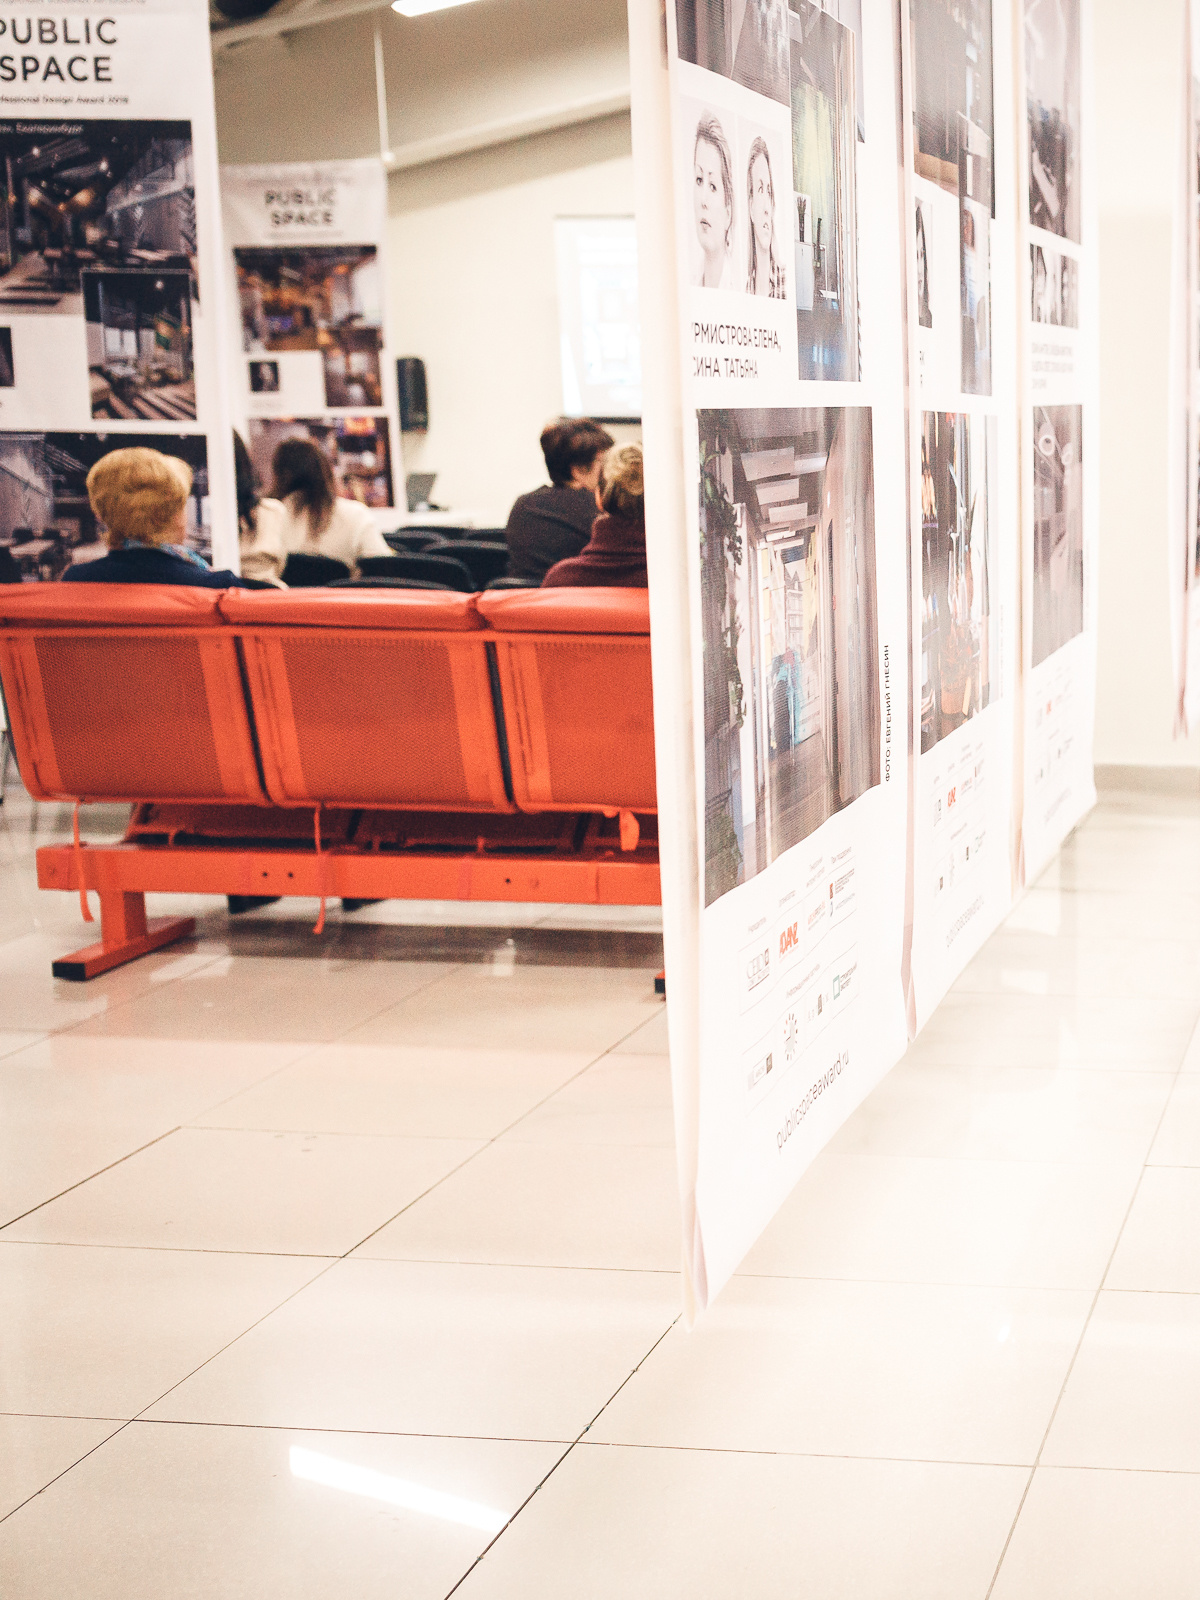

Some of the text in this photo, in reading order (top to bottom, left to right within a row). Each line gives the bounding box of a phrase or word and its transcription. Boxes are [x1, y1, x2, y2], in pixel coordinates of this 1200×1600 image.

[0, 55, 113, 82] SPACE
[691, 321, 754, 347] РМИСТРОВА
[692, 355, 721, 378] ИНА
[775, 1047, 850, 1156] publicspaceaward.ru
